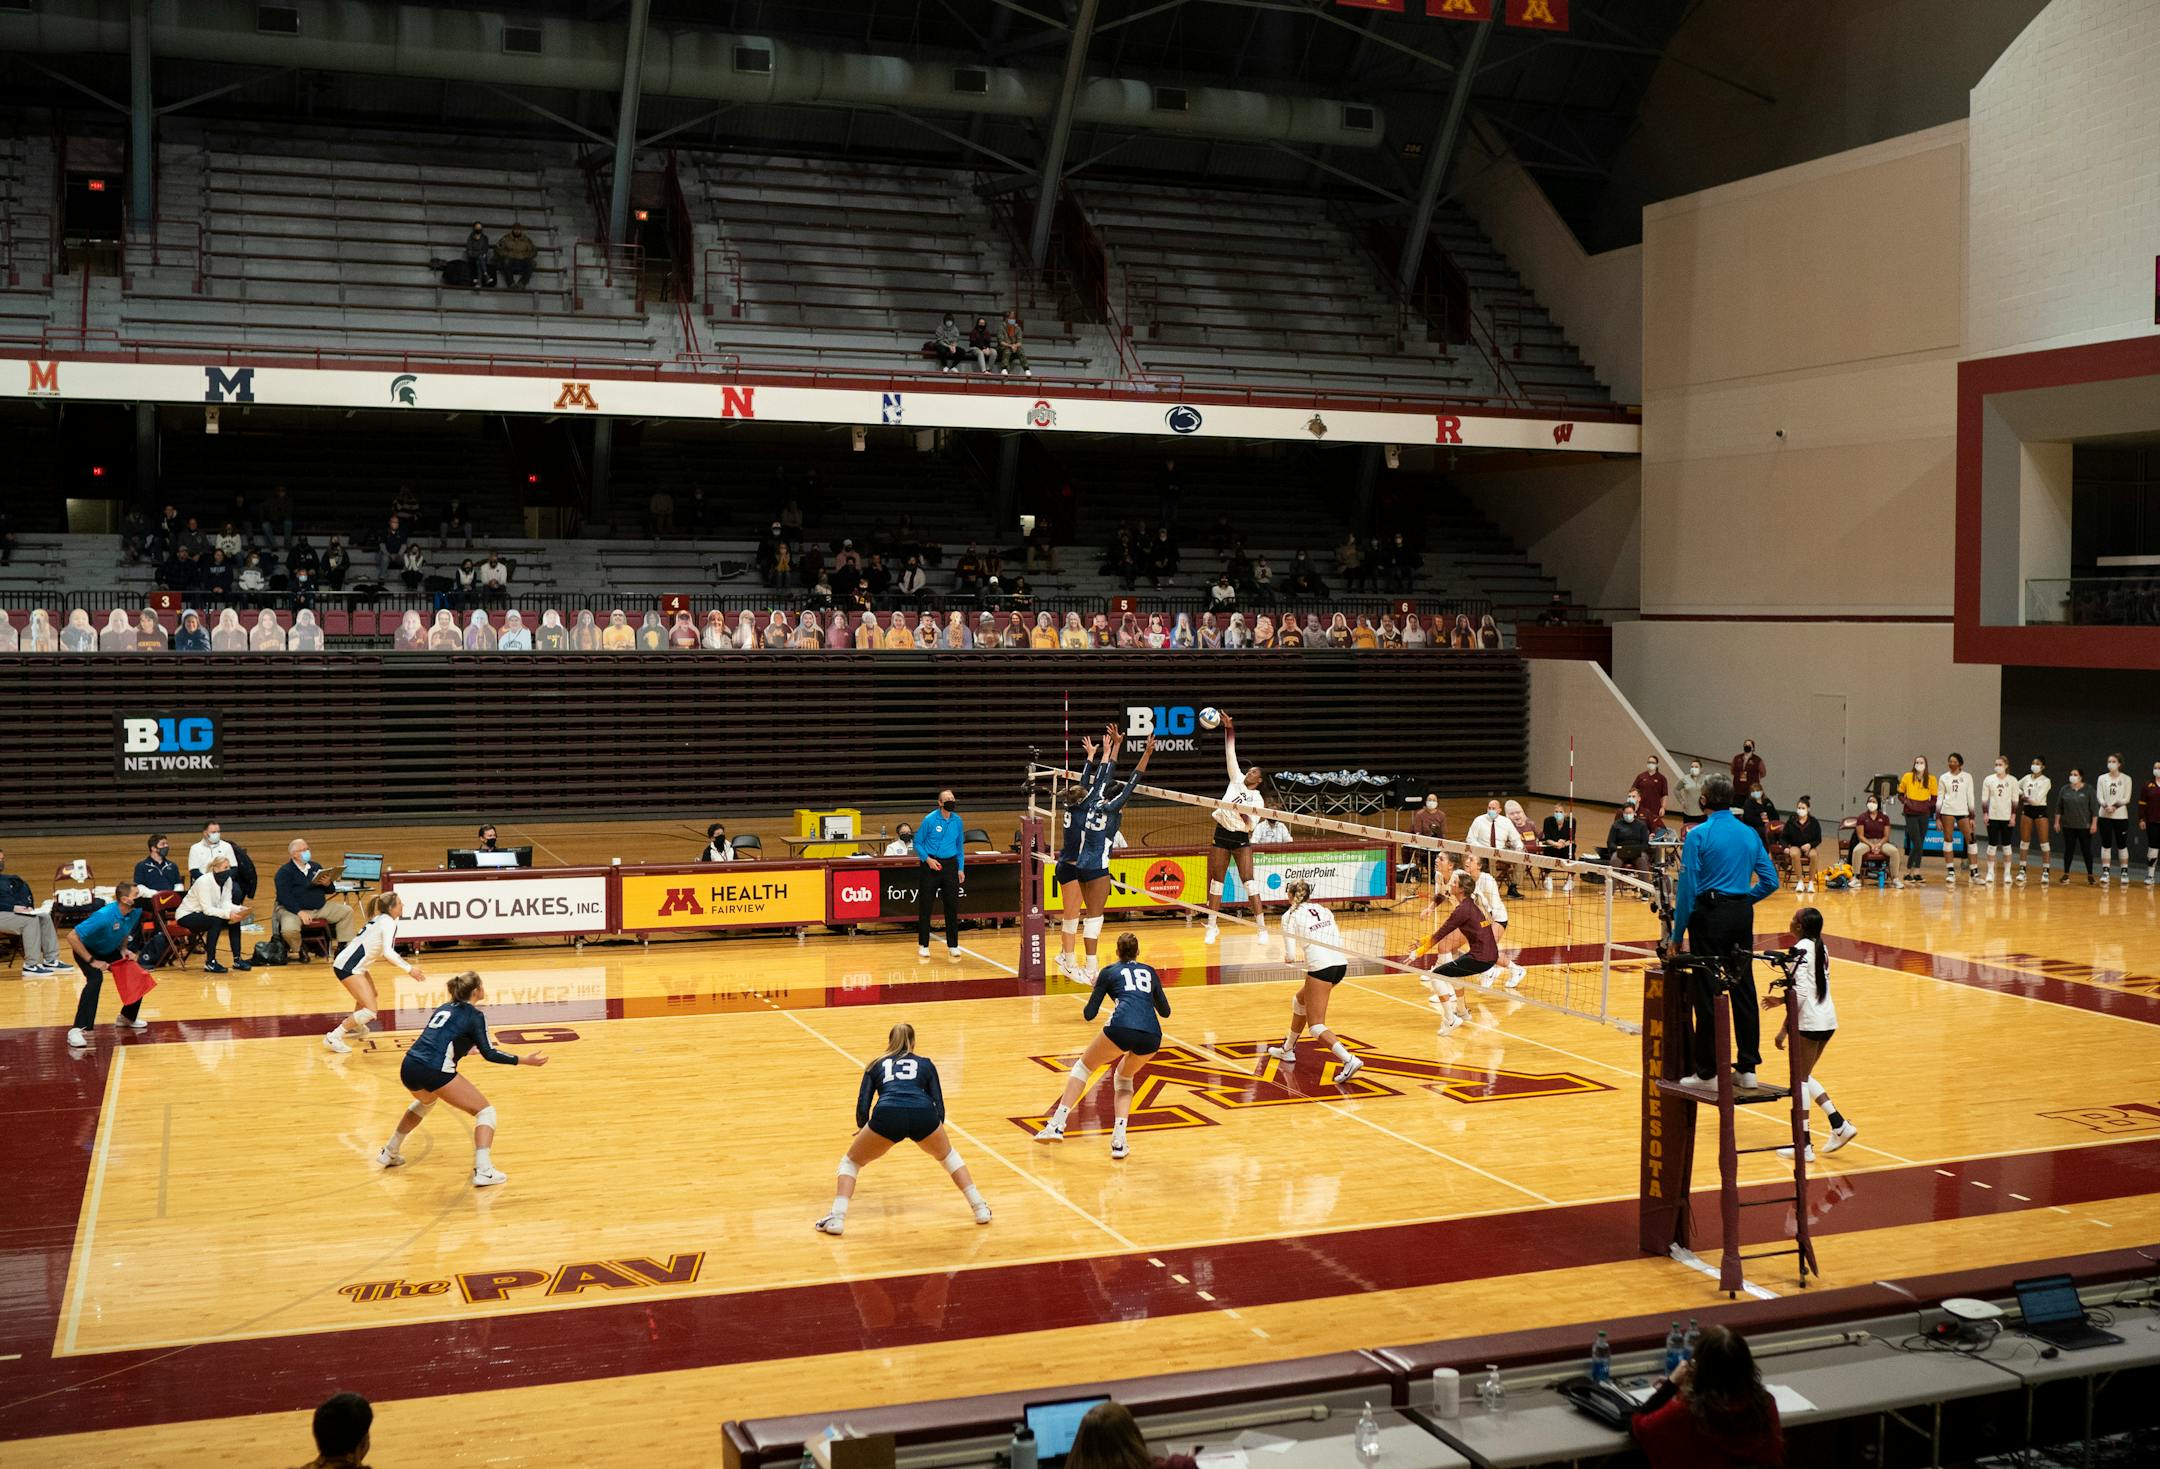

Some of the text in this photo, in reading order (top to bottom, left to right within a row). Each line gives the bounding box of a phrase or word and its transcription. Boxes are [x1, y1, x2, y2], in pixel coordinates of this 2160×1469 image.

[27, 360, 60, 391] M
[205, 367, 255, 402] M
[553, 382, 599, 411] M
[721, 386, 755, 417] N
[1435, 416, 1463, 444] R
[1553, 423, 1574, 445] W
[161, 595, 170, 608] 3
[671, 597, 680, 608] 4
[1120, 600, 1128, 611] 5
[1401, 602, 1409, 613] 6
[124, 755, 214, 771] NETWORK
[1063, 811, 1072, 829] 9
[1284, 867, 1336, 878] CenterPoint
[658, 883, 788, 916] M HEALTH
[841, 887, 872, 902] Cub
[887, 885, 907, 900] for
[577, 902, 603, 915] INC.
[711, 904, 765, 915] FAIRVIEW
[1031, 934, 1041, 965] senoh
[1120, 967, 1152, 993] 18
[428, 1010, 451, 1029] 0
[881, 1058, 918, 1083] 13
[337, 1251, 706, 1304] The PAV
